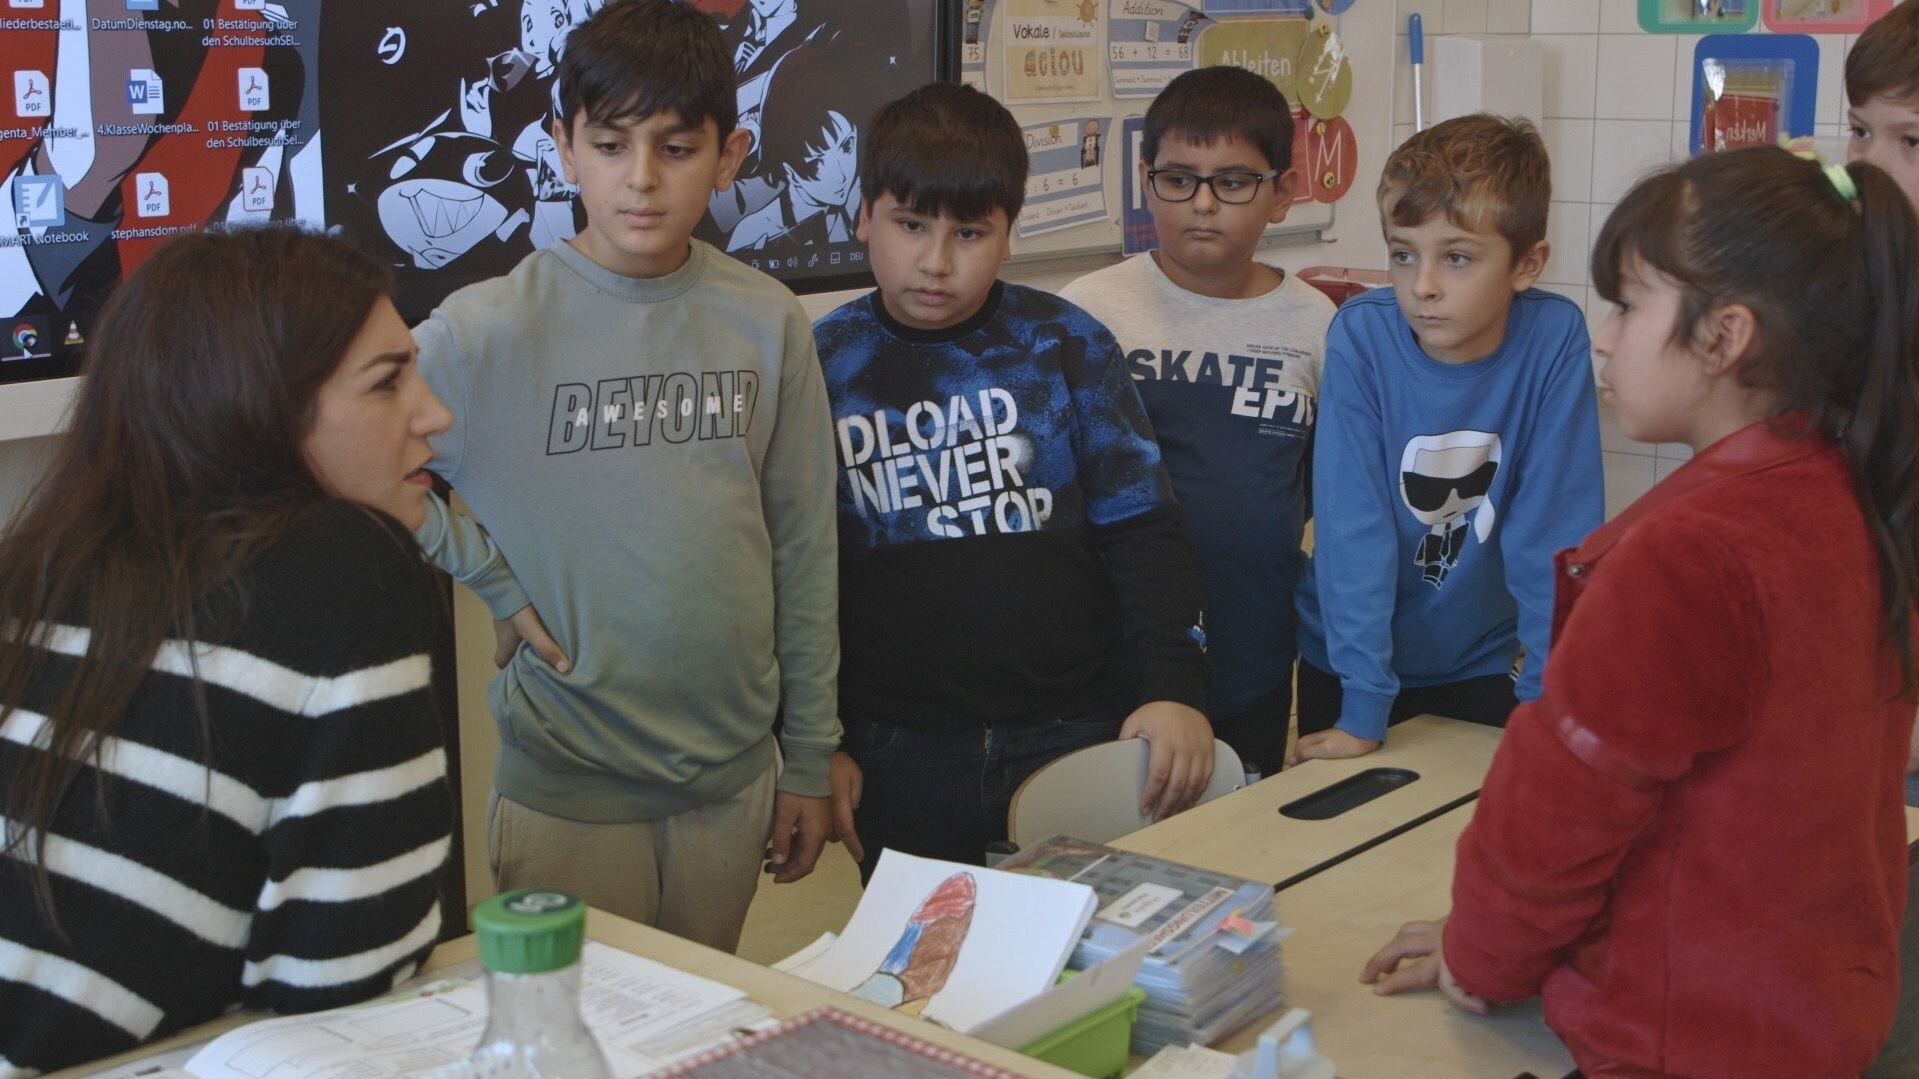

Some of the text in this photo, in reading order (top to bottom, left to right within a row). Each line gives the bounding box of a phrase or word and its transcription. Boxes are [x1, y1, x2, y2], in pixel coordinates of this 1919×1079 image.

[1122, 0, 1164, 16] Addition
[203, 18, 298, 31] 01 Bestätigung über
[1013, 24, 1050, 39] Vokale
[202, 35, 221, 46] den
[967, 46, 980, 60] 75
[1112, 46, 1125, 60] 56
[1147, 46, 1157, 59] 12
[1178, 46, 1189, 59] 68
[25, 102, 42, 112] PDF
[247, 98, 262, 106] PDF
[207, 118, 302, 132] 01 Bestätigung über
[206, 137, 225, 148] den
[1025, 133, 1063, 149] Division
[1043, 177, 1050, 192] 6
[1072, 172, 1079, 186] 6
[146, 203, 161, 212] PDF
[252, 197, 267, 206] PDF
[35, 230, 90, 245] Notebook
[850, 252, 864, 262] DEU
[1126, 348, 1283, 389] SKATE
[546, 370, 760, 456] BEYOND
[575, 394, 744, 427] AWESOME
[1231, 385, 1315, 426] EPI
[837, 387, 1018, 468] DLOAD
[847, 435, 1026, 518] NEVER
[926, 487, 1053, 538] STOP
